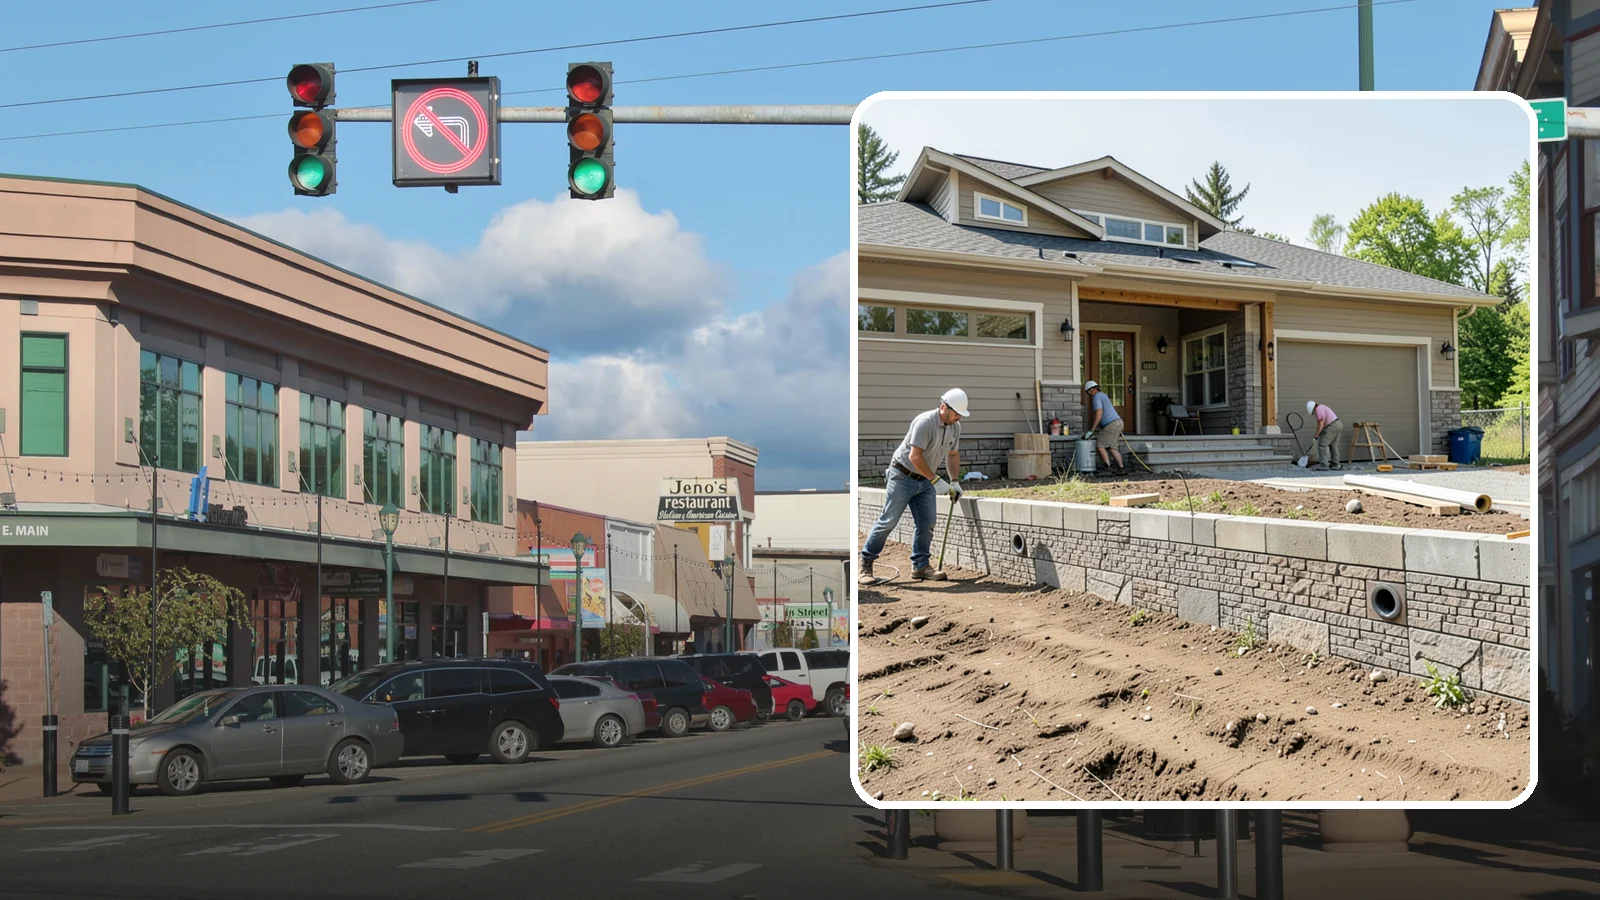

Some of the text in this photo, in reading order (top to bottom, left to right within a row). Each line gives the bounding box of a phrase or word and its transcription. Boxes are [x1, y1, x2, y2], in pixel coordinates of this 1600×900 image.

[670, 480, 727, 495] Jeno's
[665, 496, 731, 509] restaurant
[659, 510, 681, 519] Italian
[686, 510, 714, 519] American
[715, 510, 738, 519] Cuisine
[2, 525, 49, 536] E. MAIN
[797, 607, 829, 617] Street
[790, 619, 824, 627] lass
